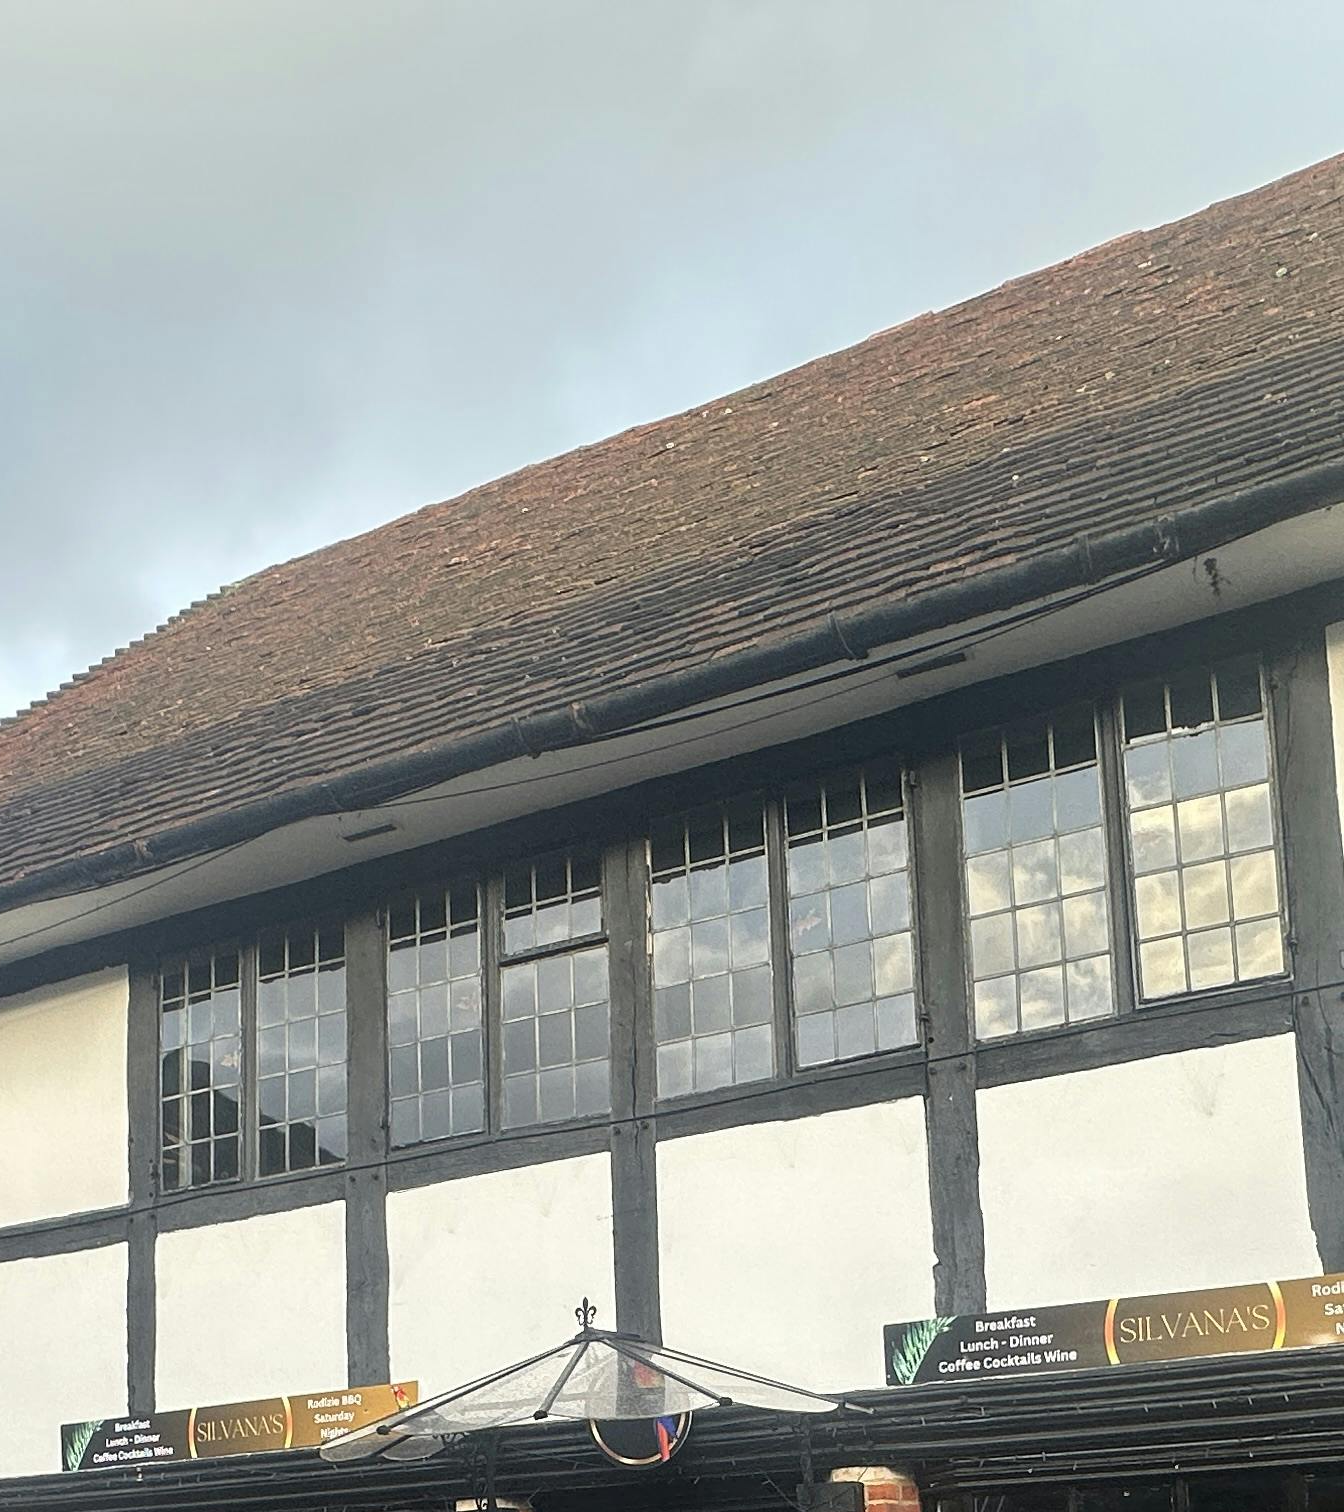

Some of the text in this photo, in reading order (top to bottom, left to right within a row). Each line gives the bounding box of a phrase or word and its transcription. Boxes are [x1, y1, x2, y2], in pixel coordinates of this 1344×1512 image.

[975, 1316, 1036, 1333] Breakfast
[1120, 1304, 1270, 1343] SILVANA'S
[960, 1337, 999, 1353] Lunch
[1009, 1333, 1054, 1349] Dinner
[938, 1349, 1077, 1374] Coffee Cocktails Wine
[342, 1394, 362, 1406] BBQ
[314, 1411, 355, 1424] Saturday
[114, 1420, 151, 1433] Breakfast
[197, 1414, 284, 1442] SILVANA'S
[106, 1436, 129, 1448] Lunch
[134, 1433, 160, 1445] Dinner
[93, 1452, 117, 1463] Coffee
[118, 1448, 153, 1461] Cocktails
